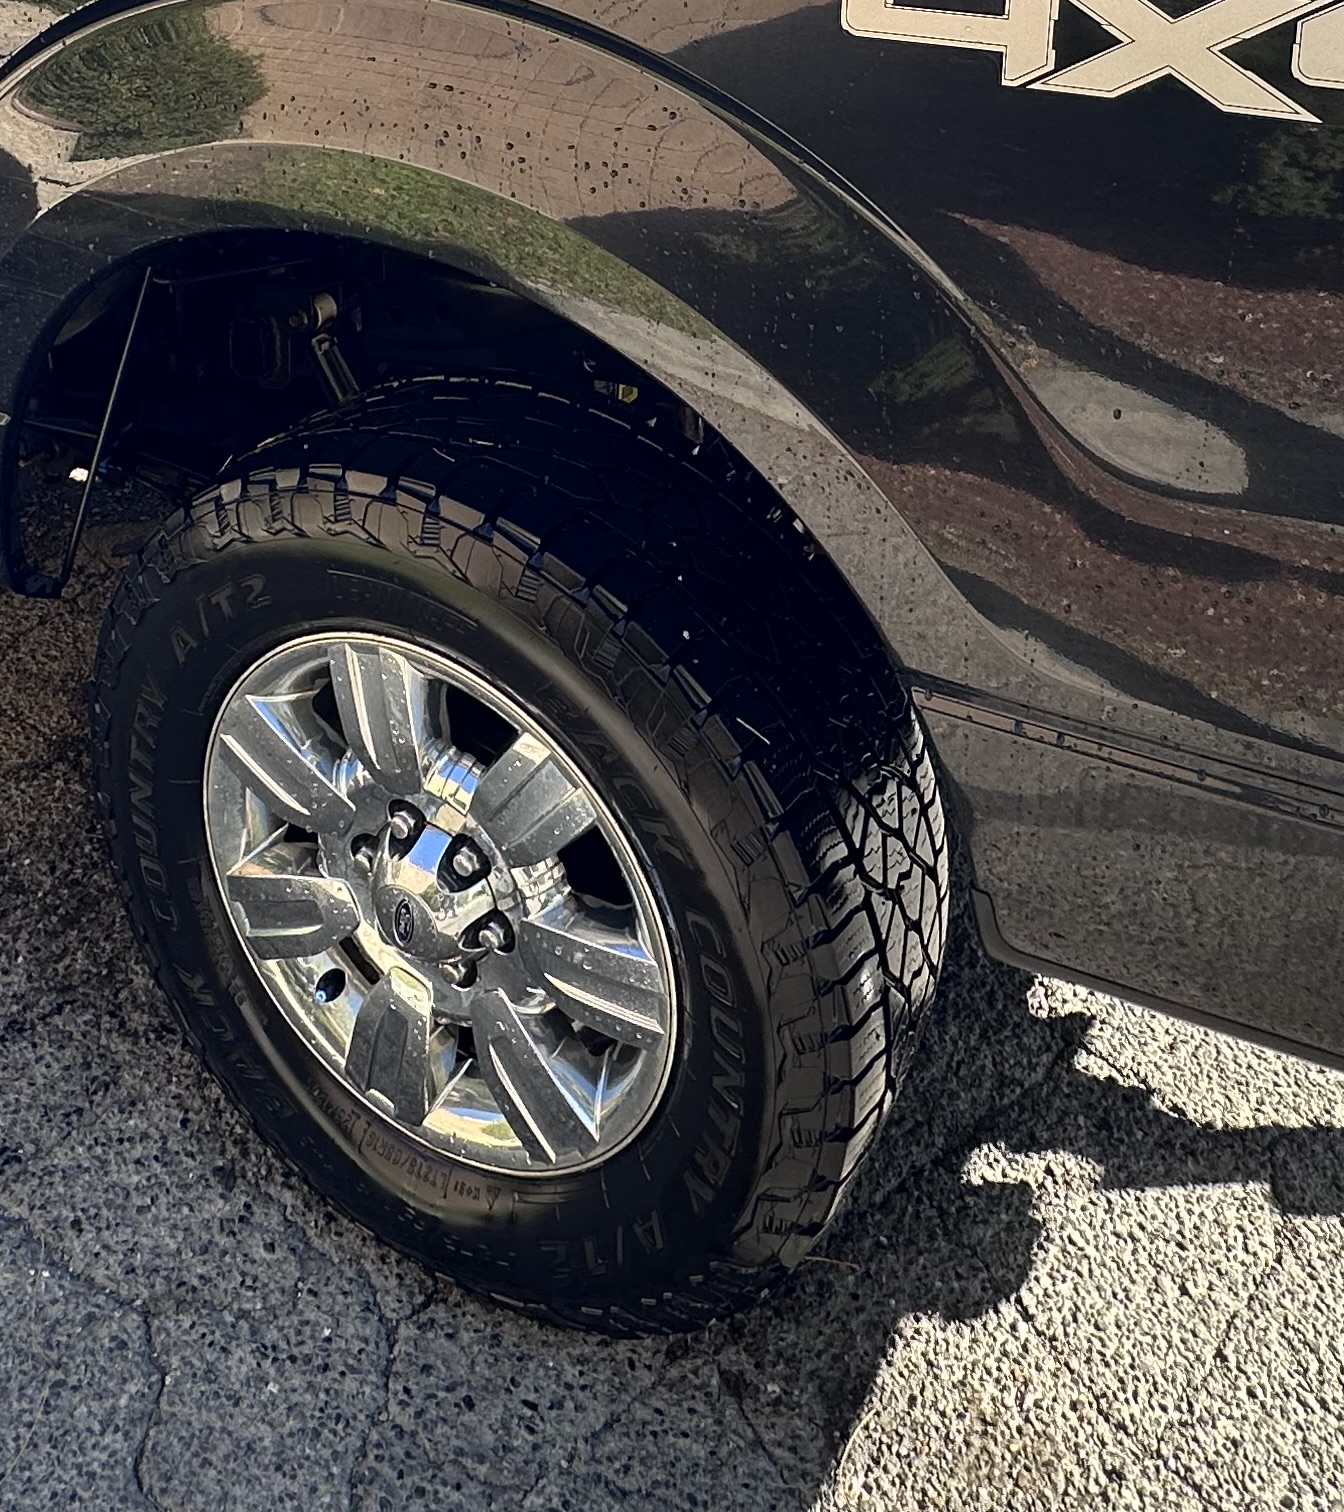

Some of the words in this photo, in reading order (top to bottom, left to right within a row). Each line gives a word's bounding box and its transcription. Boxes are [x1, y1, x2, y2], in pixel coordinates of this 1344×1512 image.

[169, 573, 270, 666] A/T2
[128, 677, 181, 931] COUNTRY
[174, 964, 299, 1120] BACK
[683, 909, 743, 1216] COUNTRY
[540, 1208, 667, 1278] A/T2
